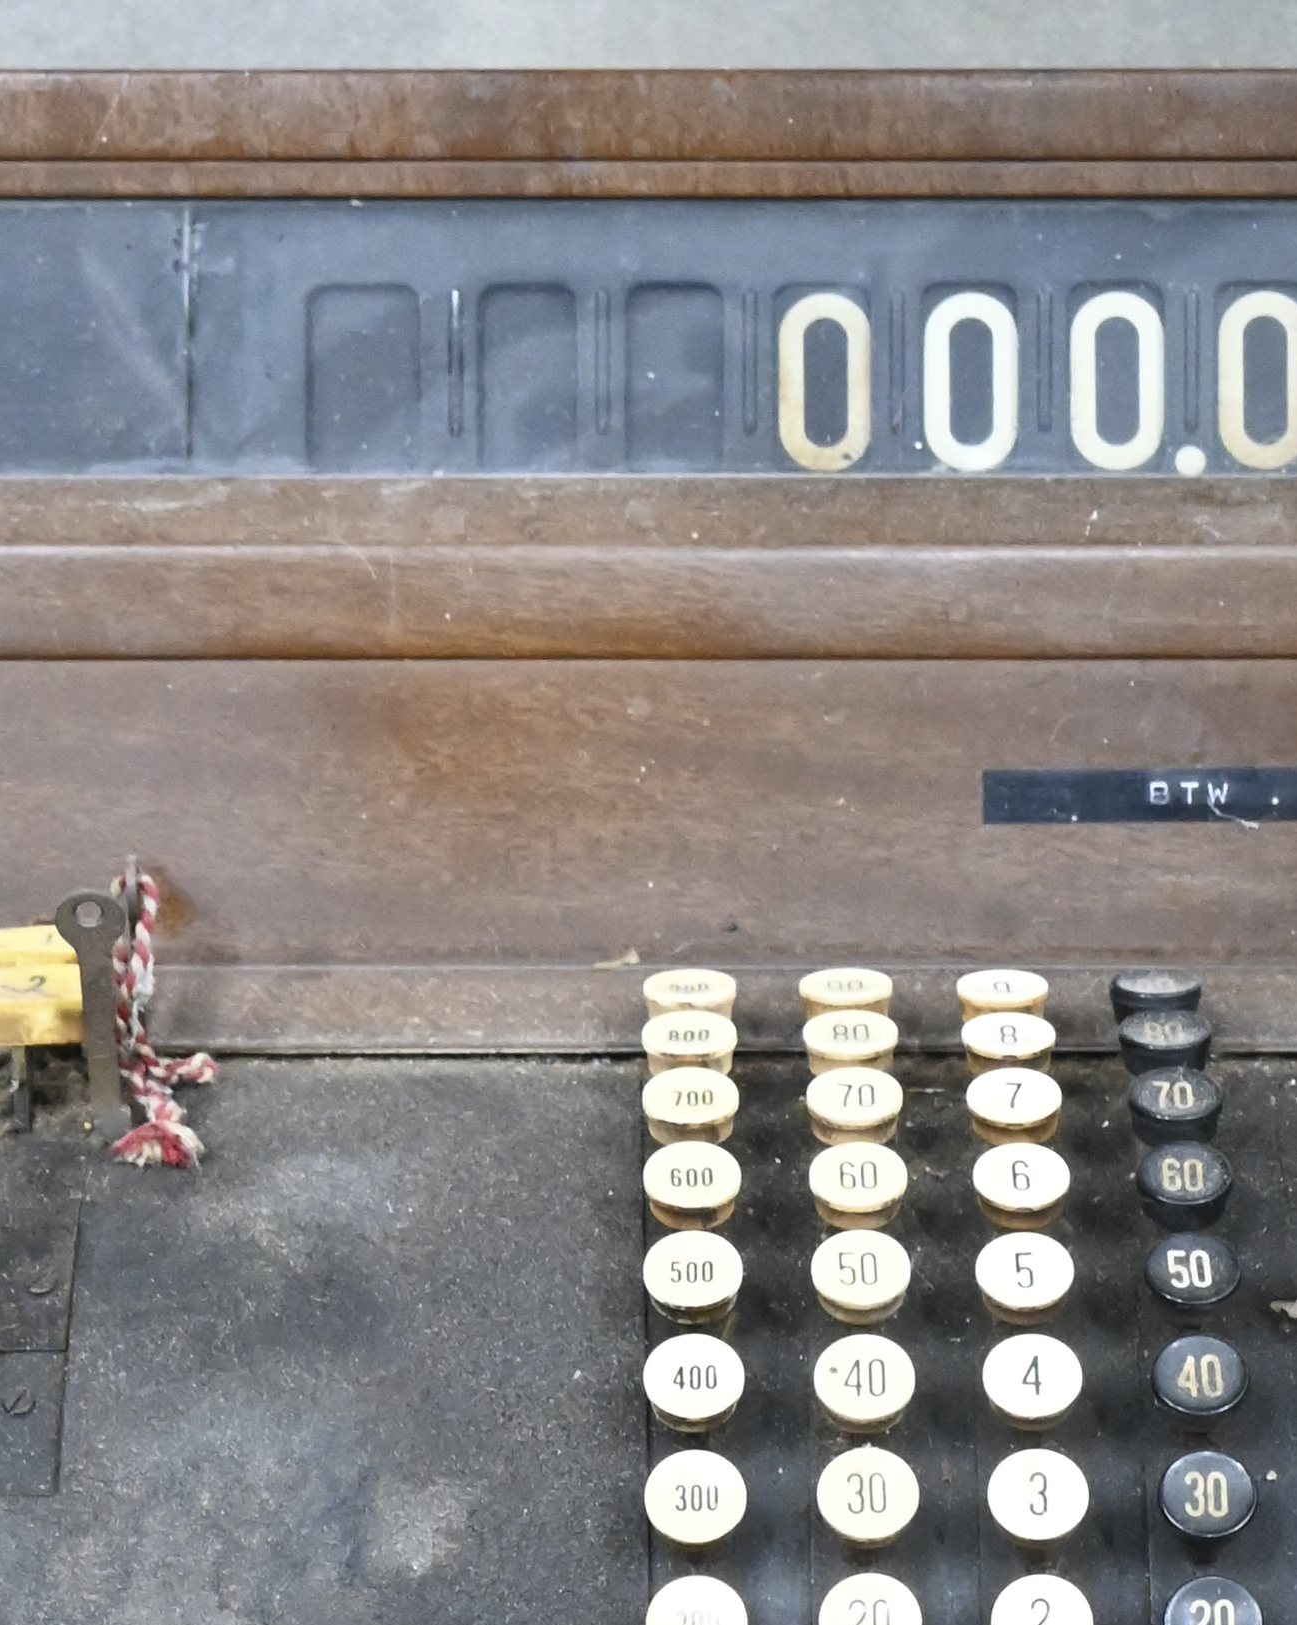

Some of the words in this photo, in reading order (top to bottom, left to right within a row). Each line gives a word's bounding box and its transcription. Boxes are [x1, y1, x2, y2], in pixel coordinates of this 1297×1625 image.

[29, 975, 47, 993] 2
[668, 1029, 710, 1043] 800
[832, 1023, 870, 1042] 80
[999, 1024, 1018, 1044] 8
[673, 1089, 714, 1106] 700
[836, 1083, 875, 1107] 70
[1006, 1082, 1023, 1108] 7
[1153, 1080, 1194, 1109] 70
[669, 1167, 714, 1188] 600
[839, 1160, 878, 1190] 60
[1010, 1159, 1031, 1191] 6
[1161, 1157, 1203, 1191] 60
[670, 1259, 714, 1283] 500
[838, 1250, 878, 1287] 50
[1015, 1249, 1034, 1288] 5
[1167, 1249, 1210, 1288] 50
[673, 1364, 718, 1390] 400
[844, 1358, 887, 1397] 40
[1022, 1356, 1042, 1396] 4
[1178, 1355, 1222, 1397] 40
[675, 1484, 719, 1512] 300
[846, 1472, 887, 1514] 30
[1029, 1471, 1049, 1516] 3
[1184, 1471, 1228, 1517] 30
